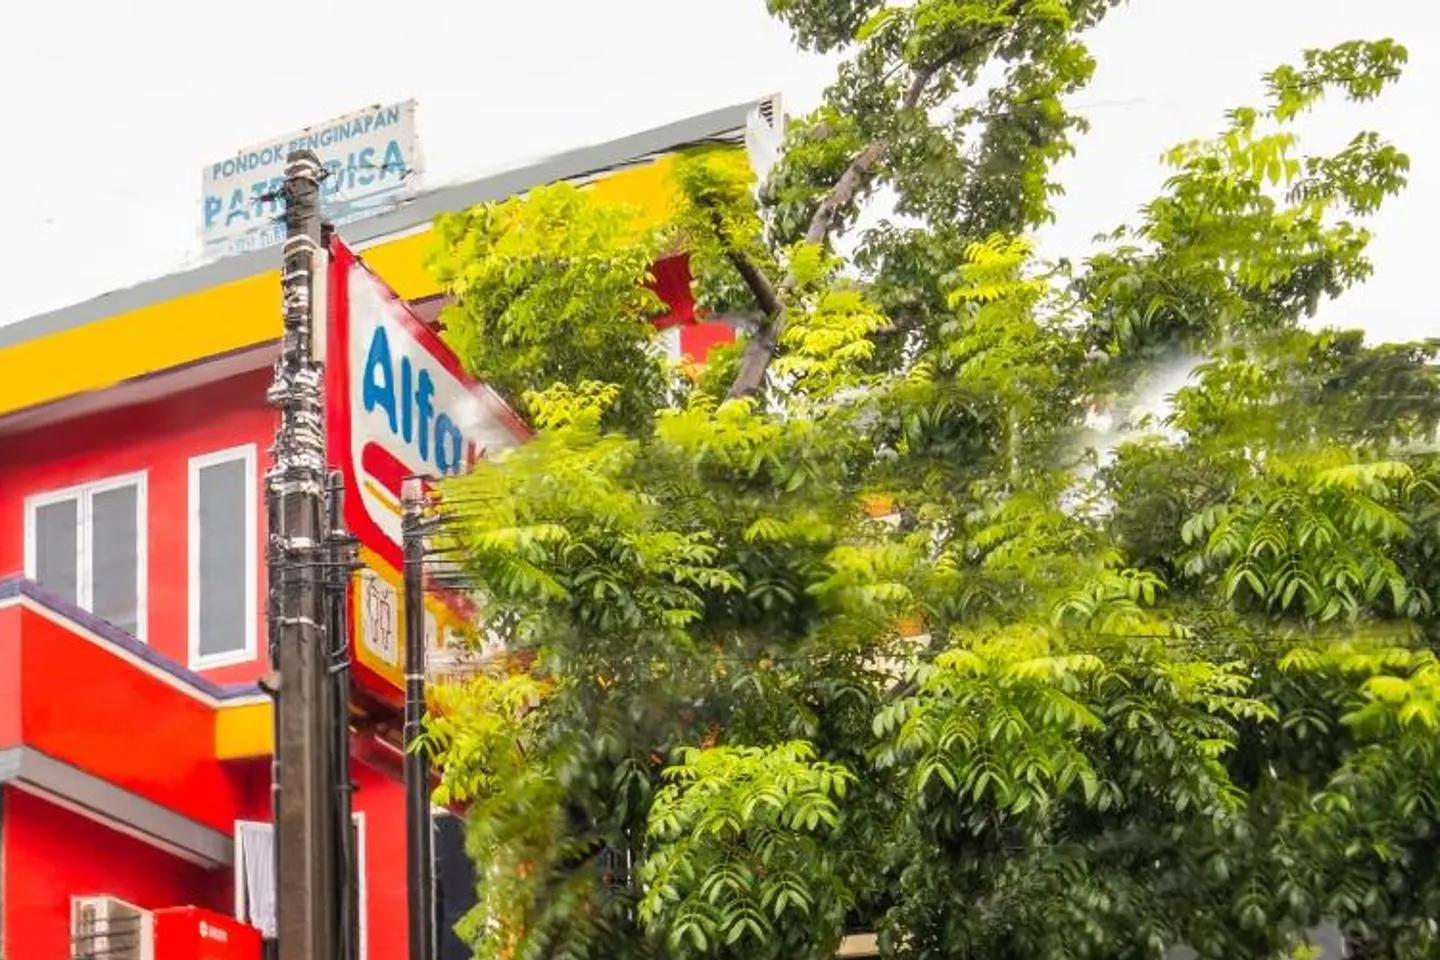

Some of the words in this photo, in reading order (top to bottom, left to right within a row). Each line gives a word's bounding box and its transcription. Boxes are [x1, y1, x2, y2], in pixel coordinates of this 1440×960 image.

[213, 143, 284, 180] PONDOK
[289, 107, 399, 150] PENGINAPAN
[205, 140, 406, 228] PATRDISA
